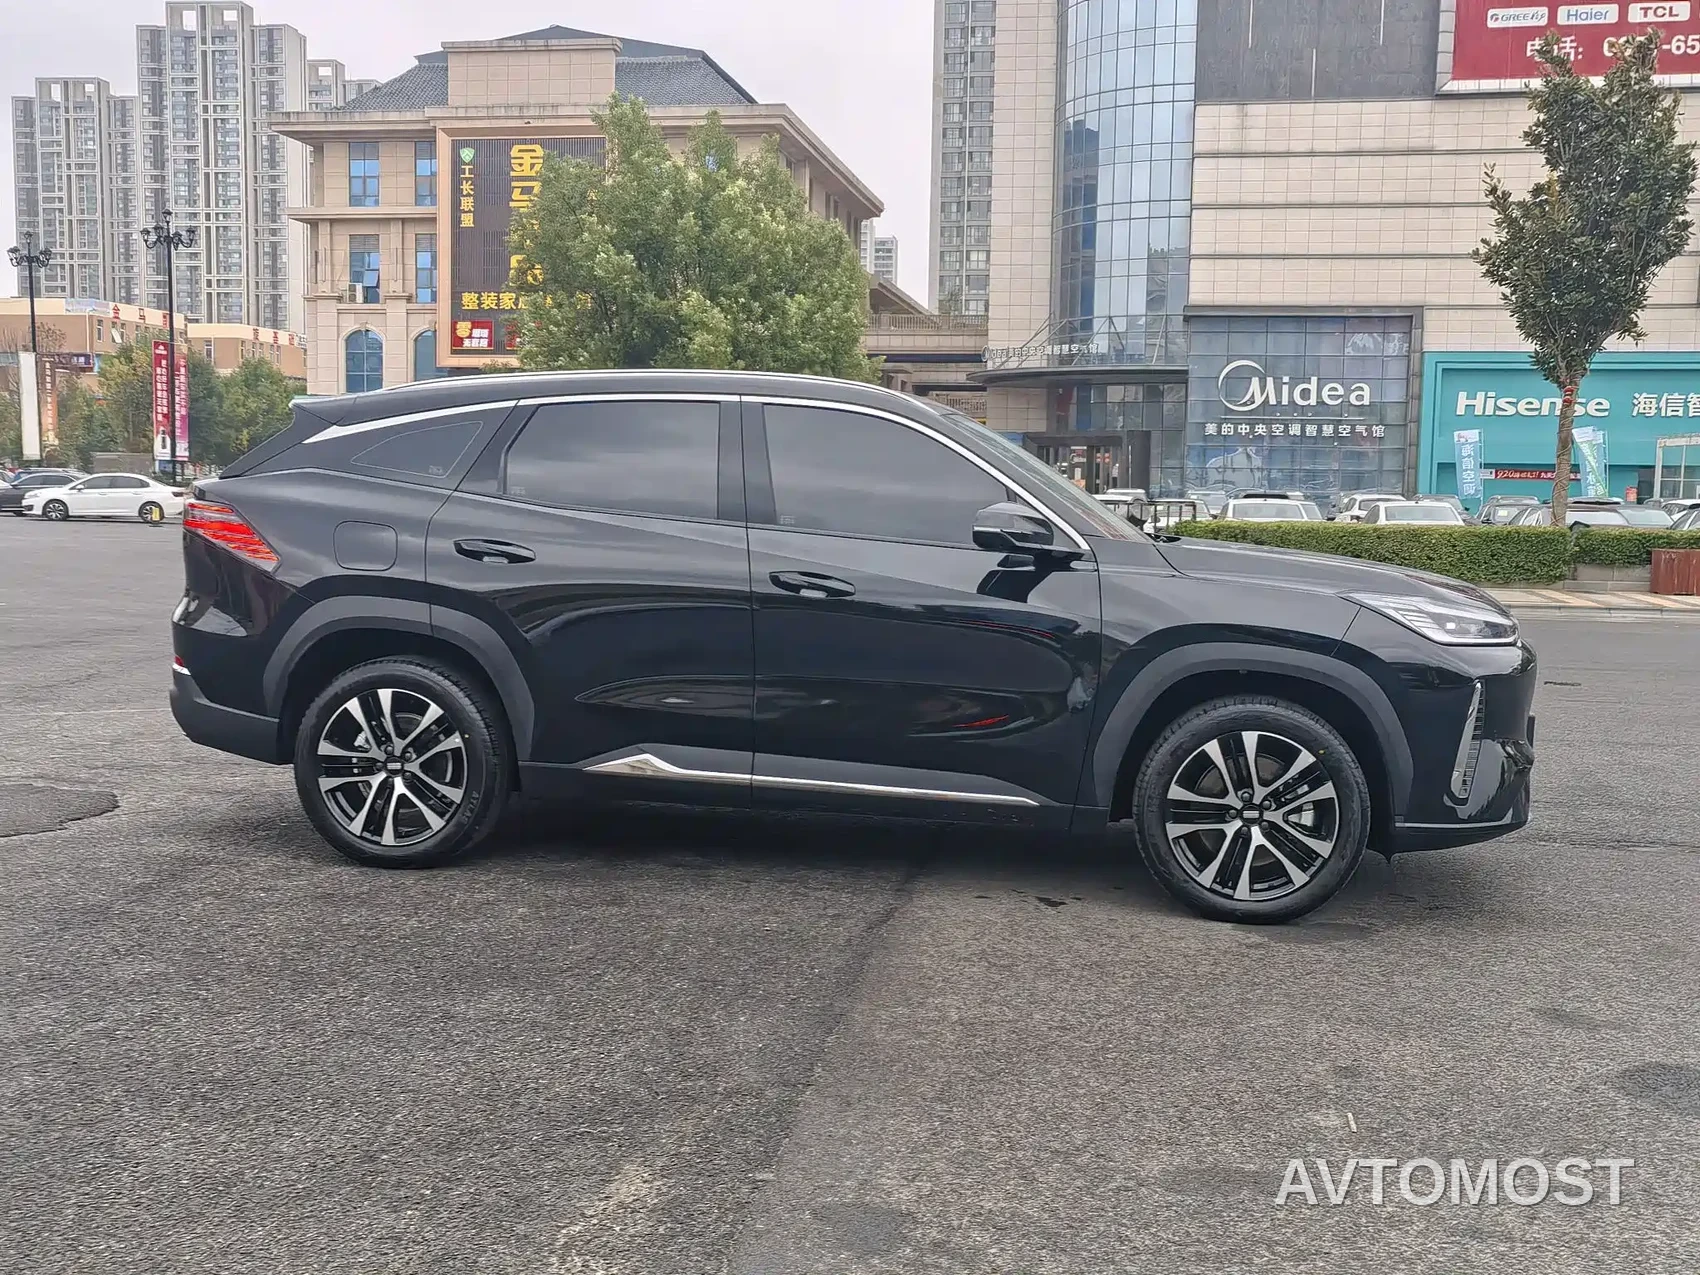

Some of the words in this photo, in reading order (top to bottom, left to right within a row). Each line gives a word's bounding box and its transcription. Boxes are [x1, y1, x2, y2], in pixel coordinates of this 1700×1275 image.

[1501, 13, 1530, 22] GREE
[1566, 9, 1610, 21] Haier
[1640, 6, 1680, 18] TCL
[460, 165, 475, 228] 工长联盟
[1227, 367, 1370, 408] Midea
[1204, 422, 1386, 438] 美的中央空调智慧空气馆
